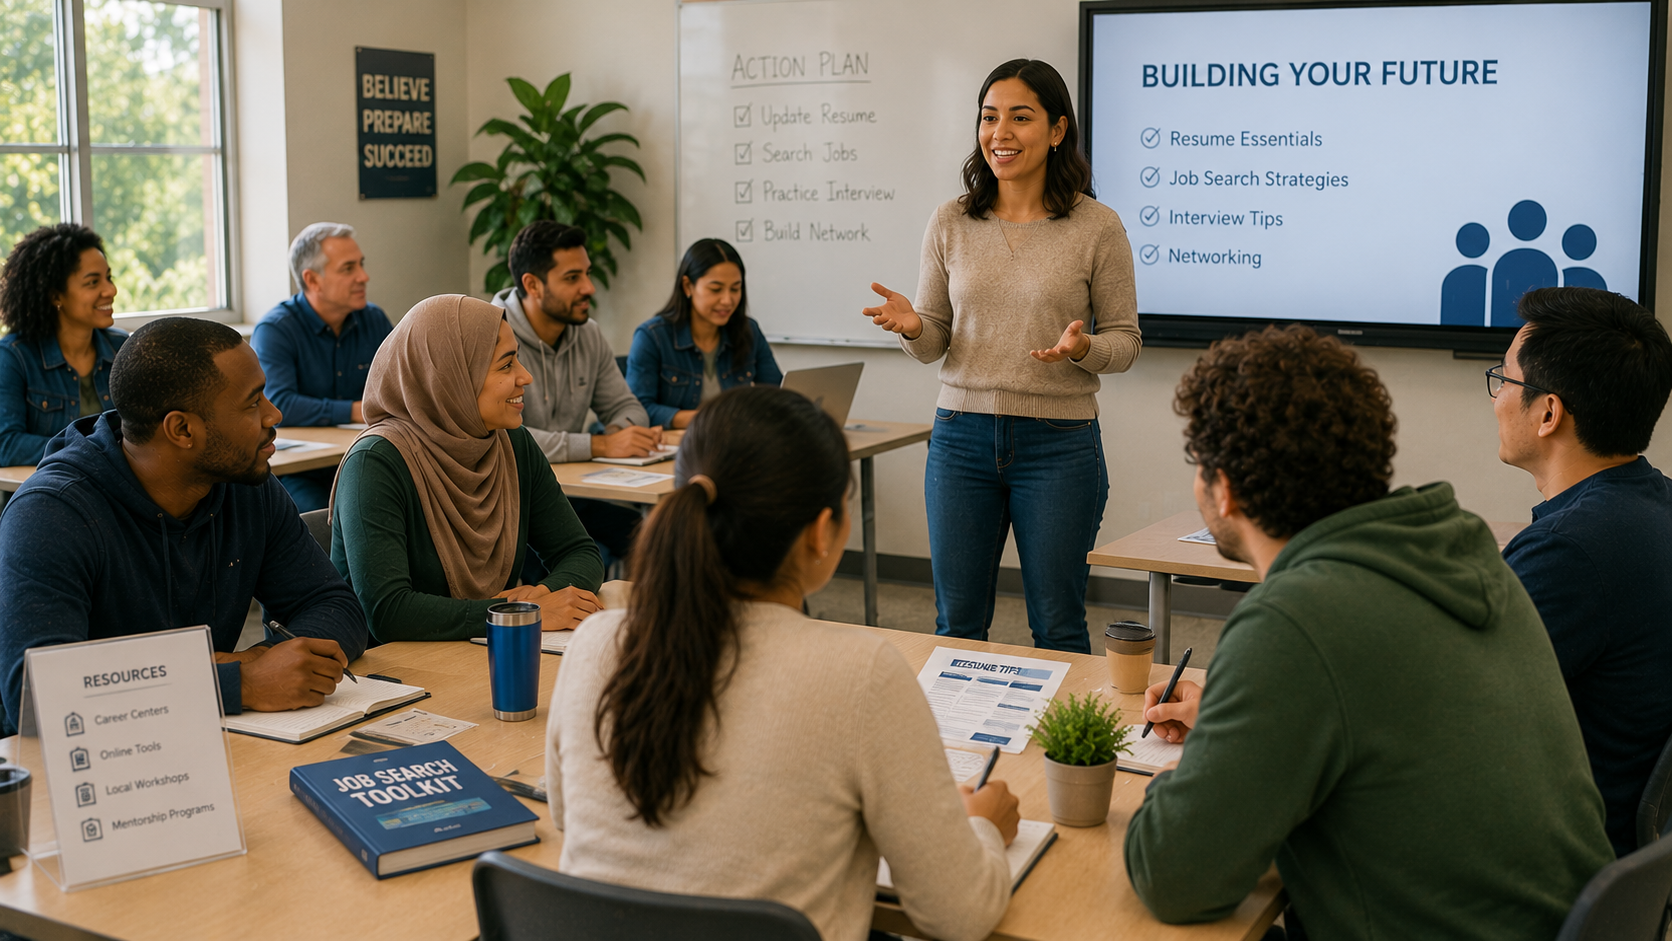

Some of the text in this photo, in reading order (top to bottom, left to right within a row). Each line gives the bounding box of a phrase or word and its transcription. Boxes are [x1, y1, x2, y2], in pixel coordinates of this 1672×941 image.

[731, 51, 869, 80] ACTION PLAN
[1142, 59, 1498, 88] BUILDING YOUR FUTURE
[362, 74, 430, 101] BELIEVE
[363, 109, 432, 134] PREPARE
[762, 103, 877, 132] Update Resume
[1170, 131, 1322, 147] Resume Essentials
[364, 144, 432, 168] SUCCEED
[763, 142, 858, 163] Search Jobs
[764, 180, 895, 202] Practice Interview
[1169, 170, 1349, 190] Job Search Strategies
[764, 220, 871, 242] Build Network
[1169, 210, 1283, 229] Interview Tips
[1169, 248, 1262, 268] Networking
[83, 665, 167, 688] RESOURCES
[95, 704, 169, 725] Career Centers
[100, 741, 161, 760] Online Tools
[105, 771, 189, 796] Local Workshops
[333, 759, 458, 793] JOB SEARCH
[350, 775, 463, 807] TOOLKIT
[112, 803, 215, 831] Mentorship Programs
